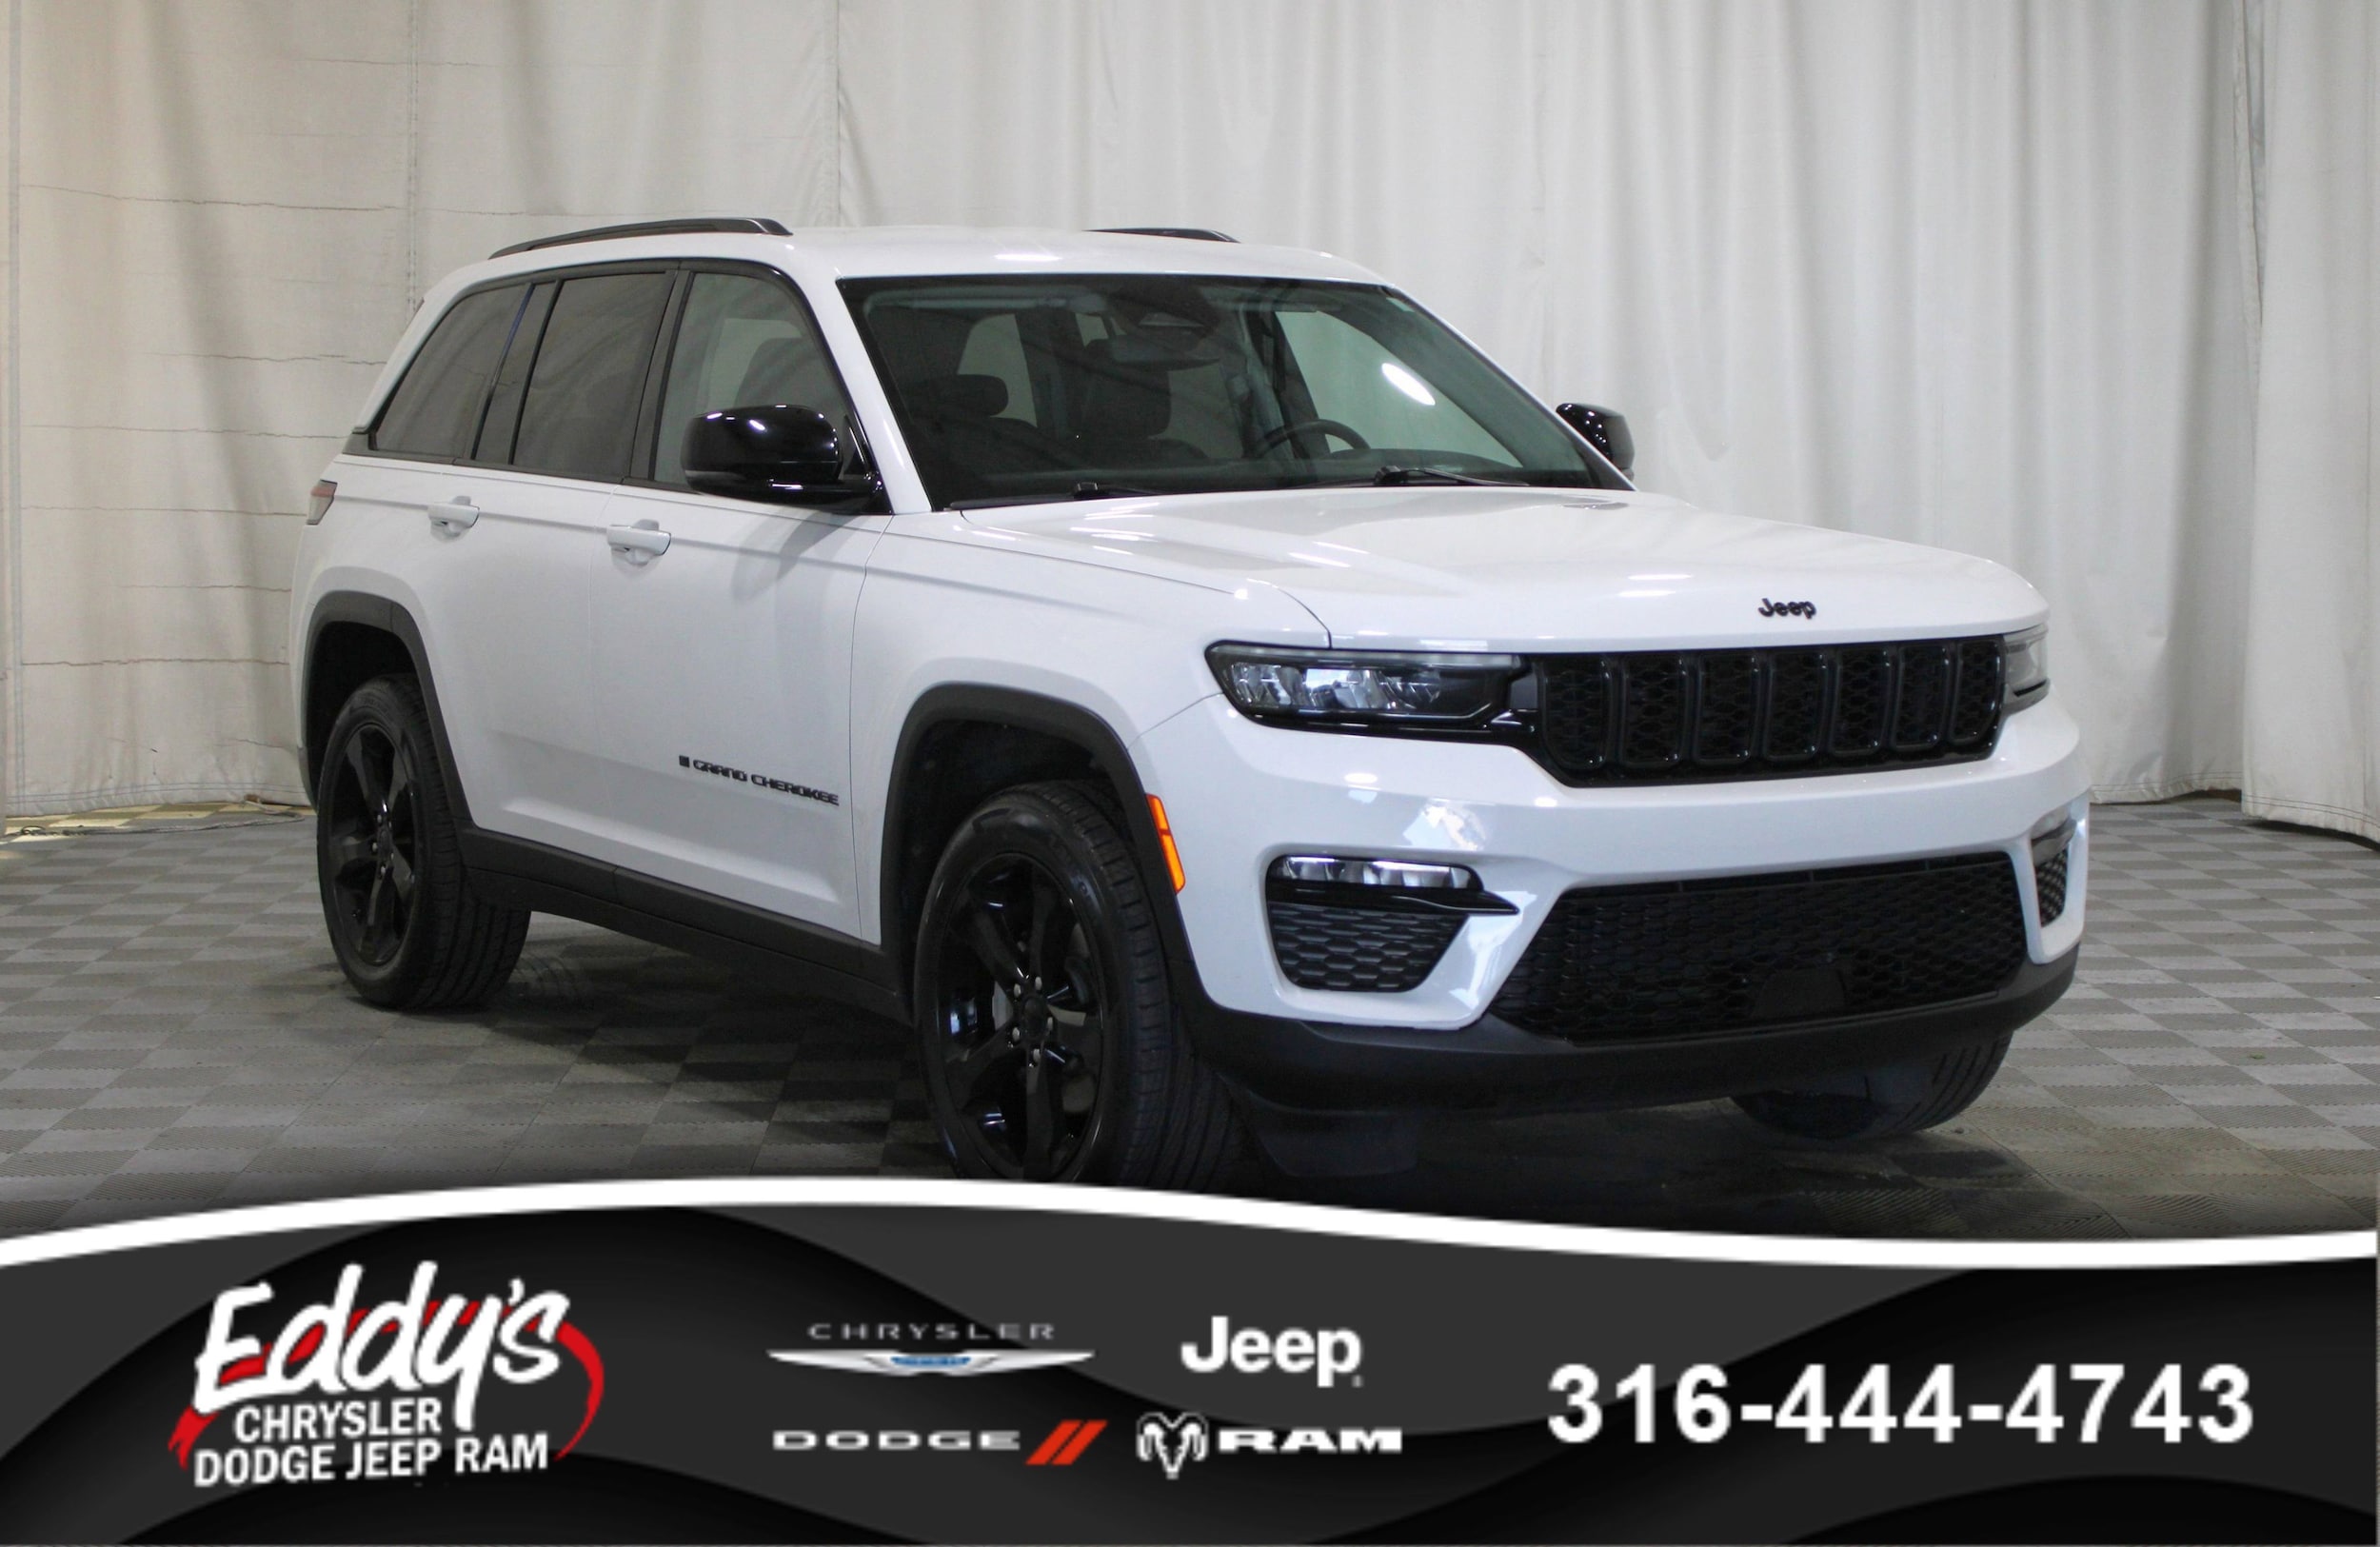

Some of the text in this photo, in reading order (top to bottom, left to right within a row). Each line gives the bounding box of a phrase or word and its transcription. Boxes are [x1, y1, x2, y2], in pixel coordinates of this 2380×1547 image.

[1757, 598, 1816, 620] Jeep
[693, 759, 840, 806] GRAND CHEROKEE
